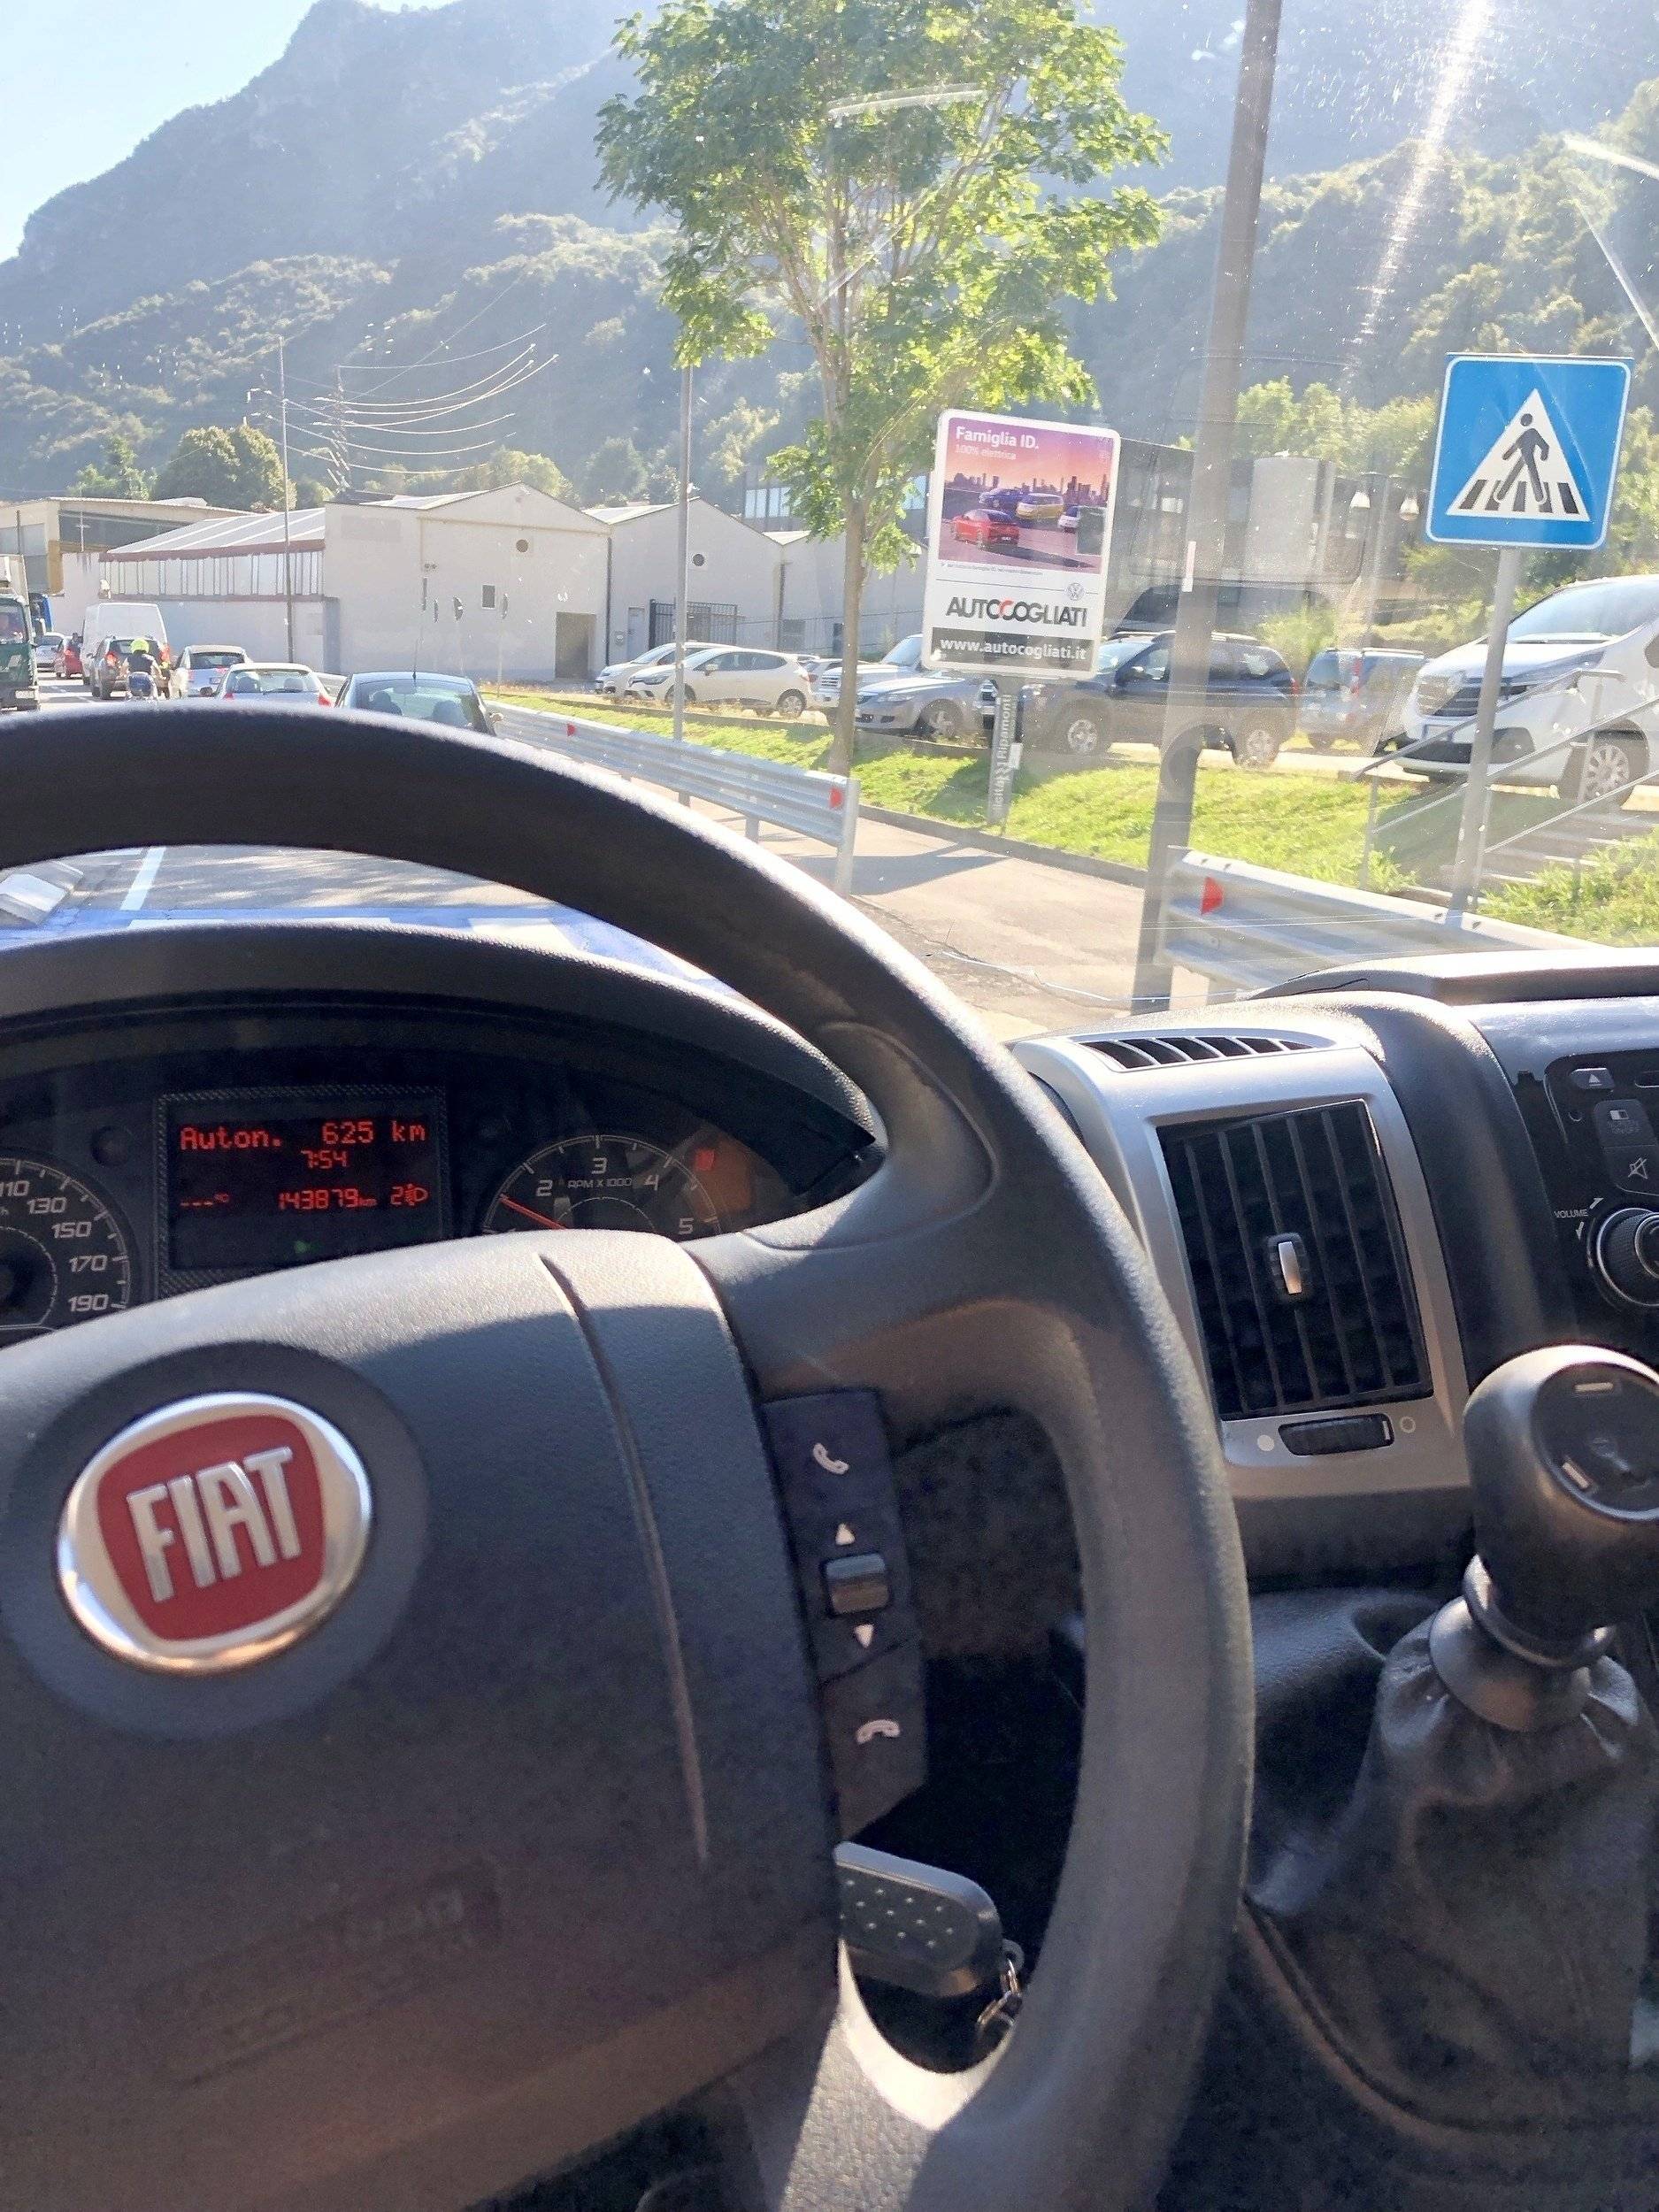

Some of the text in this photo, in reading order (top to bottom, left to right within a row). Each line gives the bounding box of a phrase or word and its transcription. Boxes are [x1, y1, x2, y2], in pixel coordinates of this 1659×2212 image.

[956, 426, 1017, 448] Famiglia
[946, 596, 1087, 626] AUTOCOGLIATI
[940, 638, 1087, 660] www.autocogliati.it
[180, 1120, 426, 1149] Auton. 625 km
[301, 1149, 347, 1169] 7:54
[591, 1157, 608, 1174] 3
[535, 1179, 553, 1197] 2
[567, 1179, 594, 1189] RPM
[606, 1178, 632, 1187] 1000
[644, 1174, 659, 1191] 4
[27, 1197, 67, 1214] 130
[1554, 1209, 1589, 1218] VOLUME
[51, 1221, 92, 1239] 150
[678, 1217, 694, 1235] 5
[69, 1255, 108, 1273] 170
[68, 1294, 109, 1312] 190
[126, 1446, 303, 1603] FIAT
